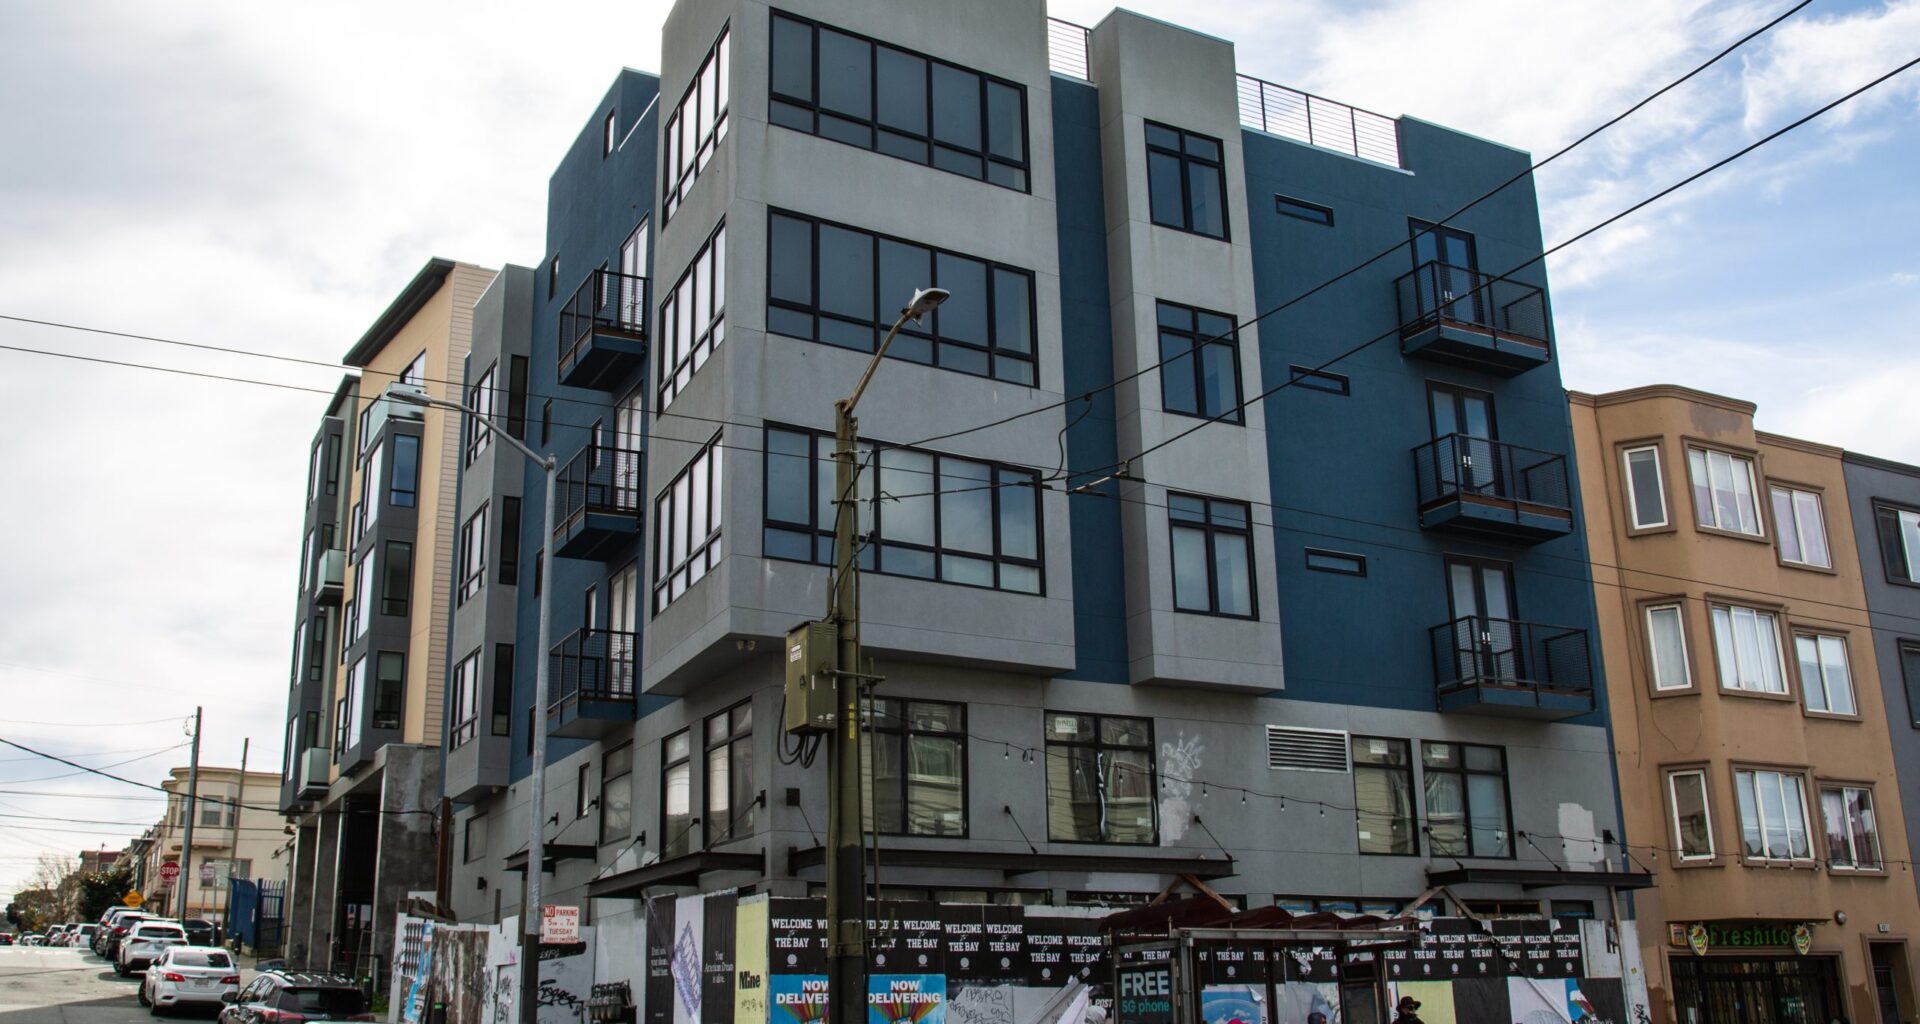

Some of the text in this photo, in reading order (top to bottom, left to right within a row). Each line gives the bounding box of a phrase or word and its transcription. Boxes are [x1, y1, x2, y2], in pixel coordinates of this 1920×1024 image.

[161, 867, 179, 875] STOP
[545, 906, 554, 917] NO
[771, 919, 813, 929] WELCOME
[903, 920, 941, 930] WELCOME
[945, 924, 982, 934] WELCOME
[987, 924, 1023, 934] WELCOME
[775, 938, 793, 948] THE
[793, 938, 810, 948] BAY
[1027, 935, 1063, 945] WELCOME
[1066, 935, 1102, 946] WELCOME
[1439, 934, 1466, 943] WELCOME
[1523, 935, 1551, 944] WELCOME
[1553, 934, 1580, 943] WELCOME
[907, 939, 922, 949] THE
[922, 939, 938, 949] BAY
[948, 942, 979, 952] THE BAY
[989, 942, 1020, 952] THE BAY
[1030, 952, 1061, 962] THE BAY
[1070, 953, 1085, 963] THE
[1085, 953, 1100, 963] BAY
[1142, 950, 1171, 961] THE BAY
[1216, 951, 1244, 961] THE BAY
[1321, 951, 1333, 960] THE
[1395, 950, 1407, 959] BAY
[1413, 950, 1437, 959] THE BAY
[1442, 950, 1465, 959] THE BAY
[1470, 949, 1493, 958] THE BAY
[1527, 950, 1550, 959] THE BAY
[1556, 949, 1579, 958] THE BAY
[739, 970, 761, 990] Mine
[1120, 970, 1170, 997] FREE
[890, 981, 920, 991] NOW
[776, 993, 829, 1004] DELIVER
[868, 993, 942, 1004] DELIVERING
[1121, 999, 1169, 1016] 5G phone
